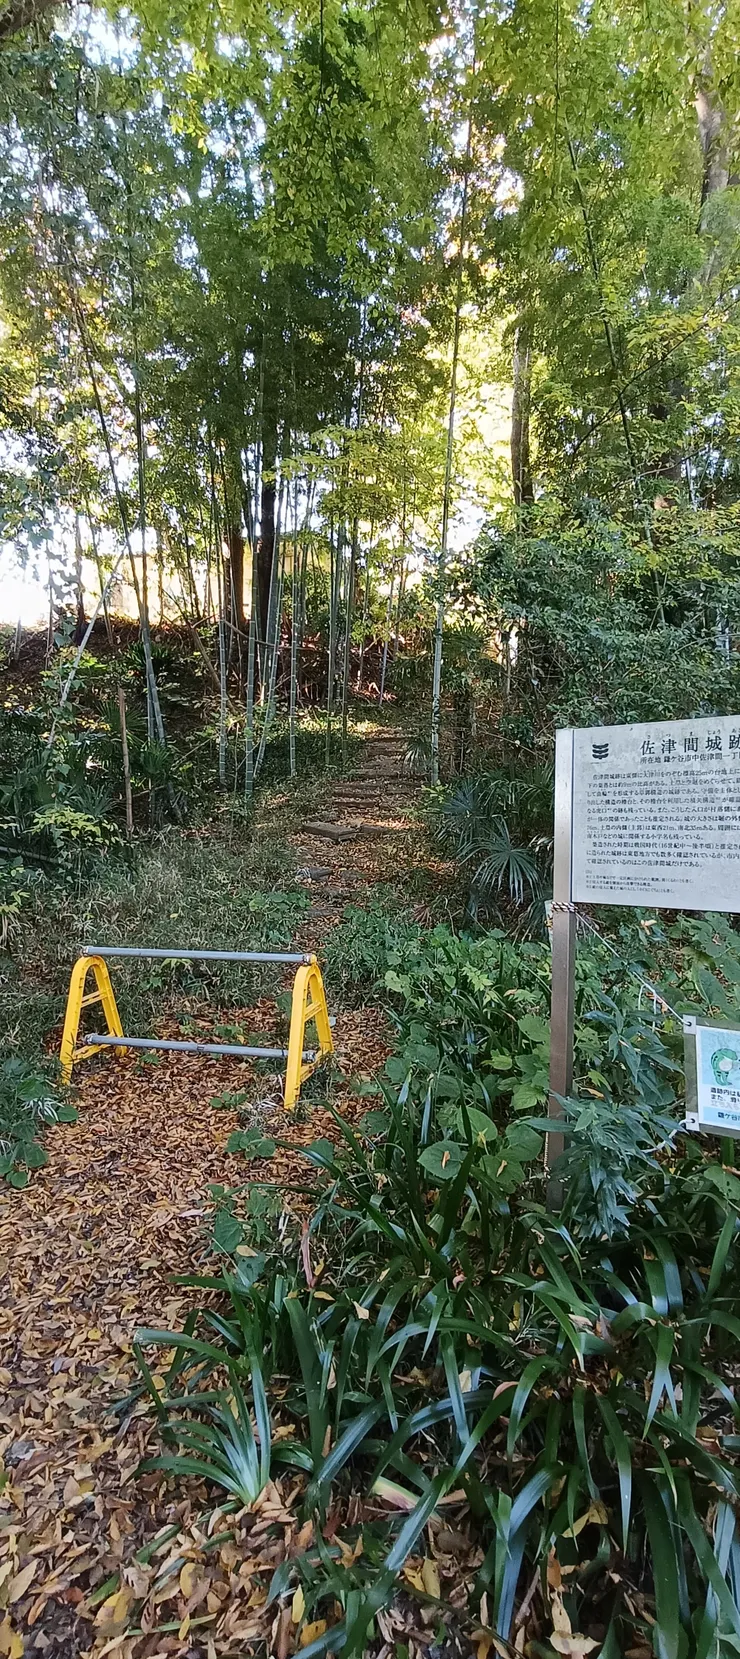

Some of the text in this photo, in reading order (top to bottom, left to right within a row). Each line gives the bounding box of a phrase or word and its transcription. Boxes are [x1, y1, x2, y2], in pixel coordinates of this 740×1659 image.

[640, 734, 740, 755] 佐津間城跡
[664, 752, 740, 763] 鎌ケ谷市中佐津間一丁
